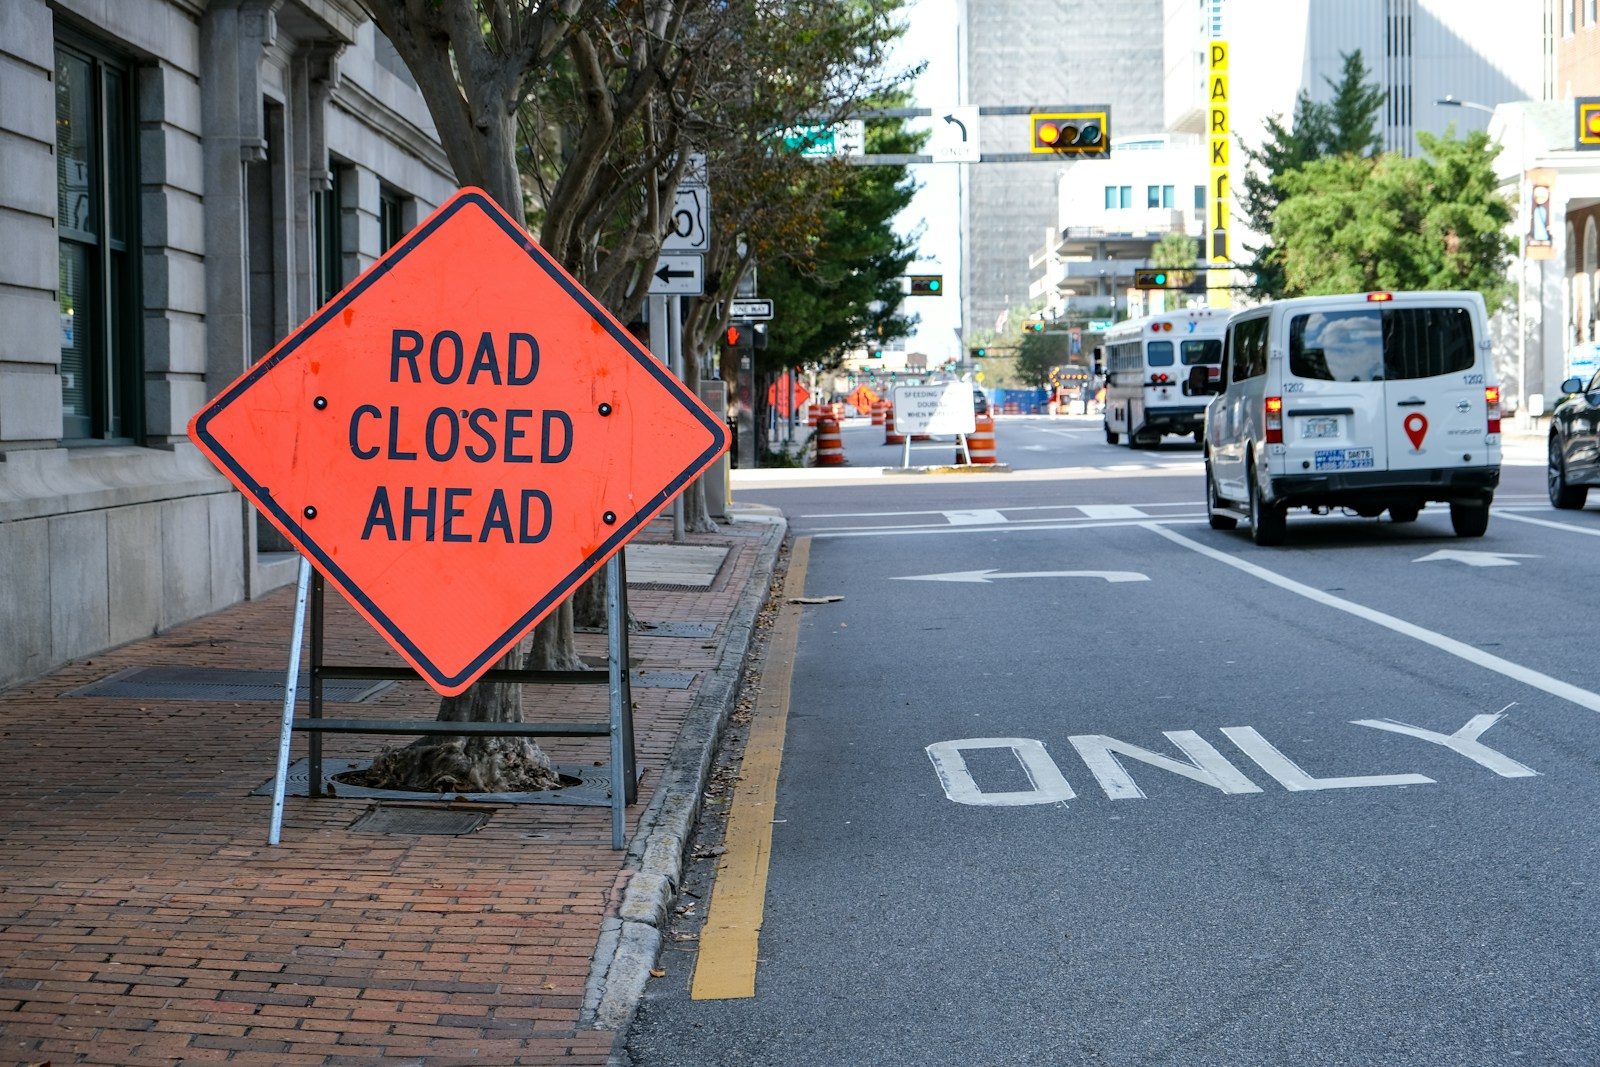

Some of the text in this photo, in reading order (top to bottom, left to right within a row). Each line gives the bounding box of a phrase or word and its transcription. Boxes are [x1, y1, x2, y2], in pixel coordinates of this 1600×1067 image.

[1211, 45, 1226, 164] PARK
[390, 329, 540, 386] ROAD
[1463, 374, 1484, 385] 1202
[1283, 382, 1305, 393] 1202
[349, 404, 574, 464] CLOSED
[361, 486, 553, 544] AHEAD
[926, 702, 1542, 806] ONLY
